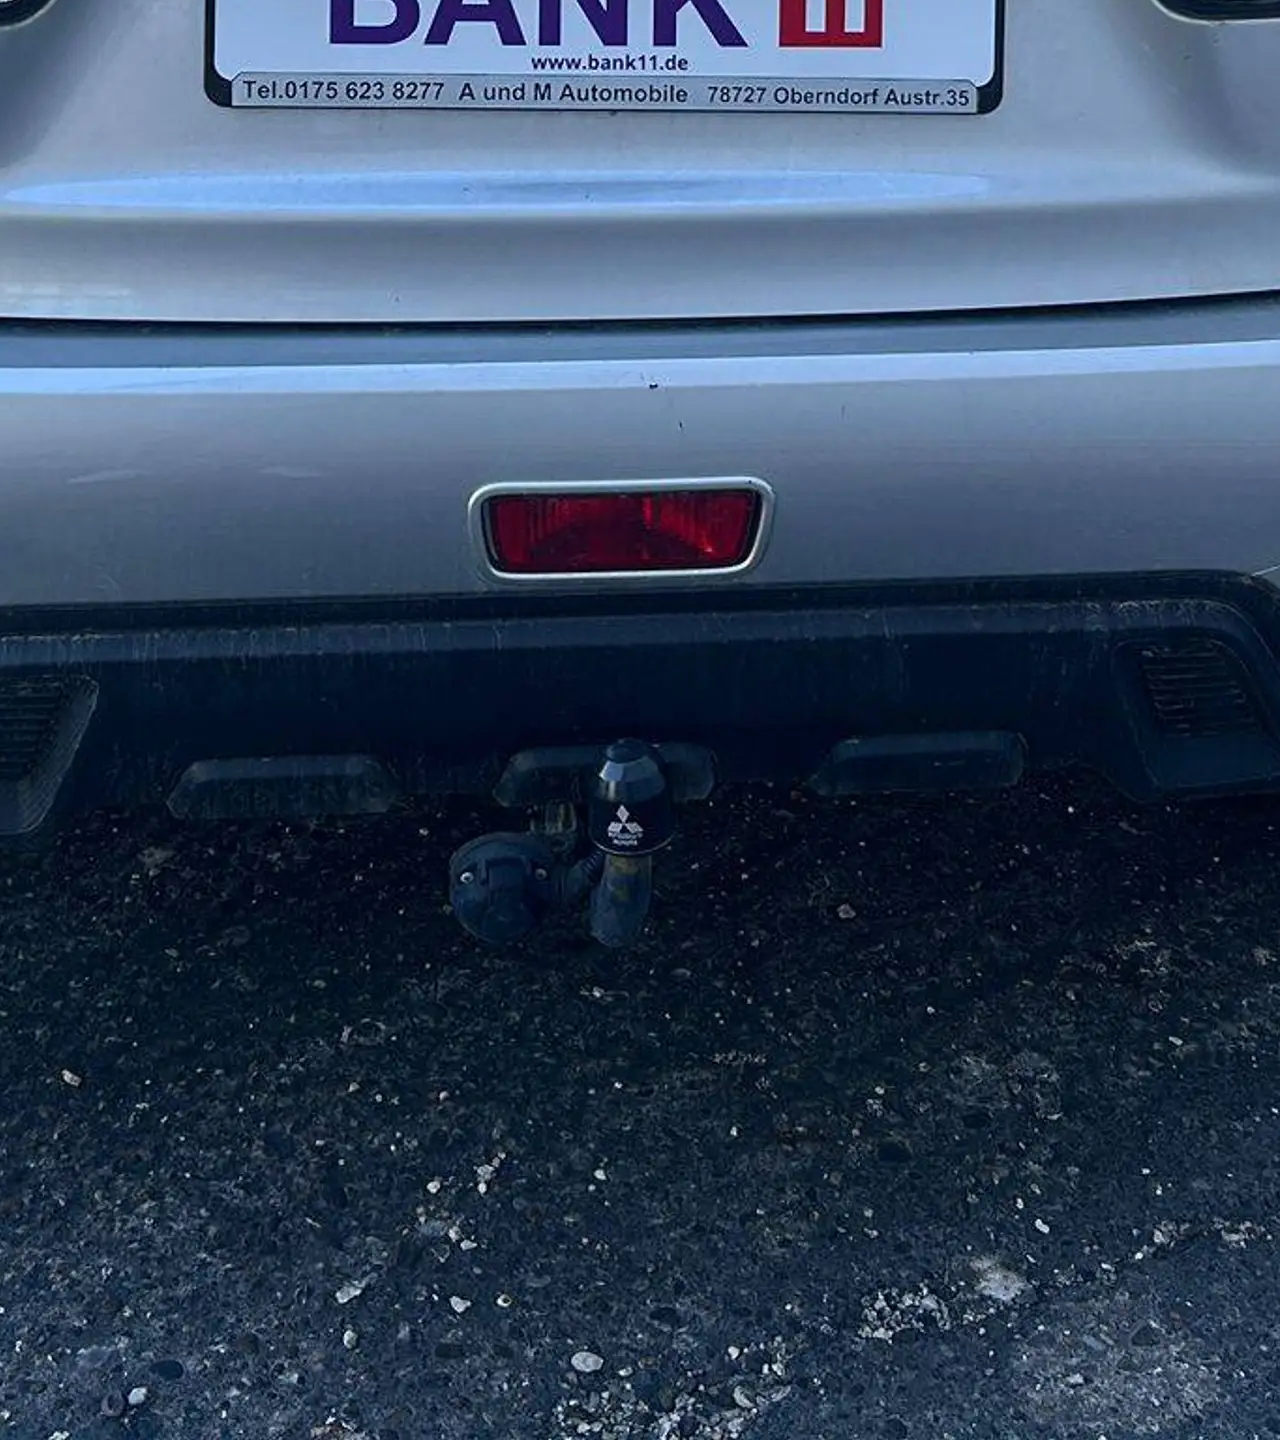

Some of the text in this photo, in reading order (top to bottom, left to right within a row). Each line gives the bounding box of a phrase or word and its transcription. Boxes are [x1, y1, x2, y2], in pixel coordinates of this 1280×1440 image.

[531, 53, 689, 71] www.bank11.de
[242, 80, 970, 107] Tel.0175 623 8277 A und M Automobile 78727 Oberndorf Austr.35
